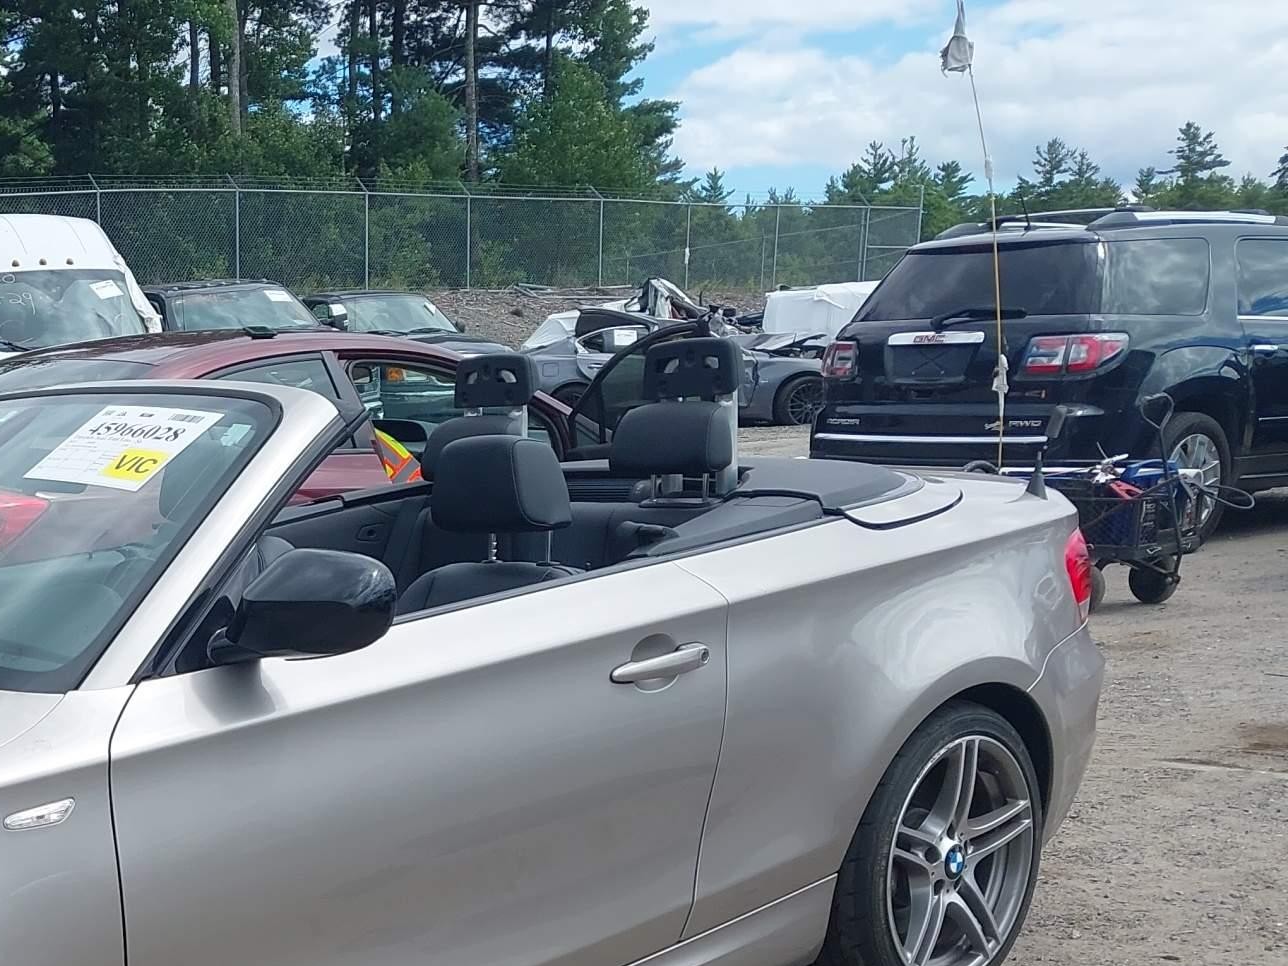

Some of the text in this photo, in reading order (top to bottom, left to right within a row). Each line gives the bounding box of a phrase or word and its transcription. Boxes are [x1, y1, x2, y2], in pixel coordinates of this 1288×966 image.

[912, 334, 946, 344] GMC
[88, 421, 187, 442] 45966028
[113, 453, 159, 474] VIC
